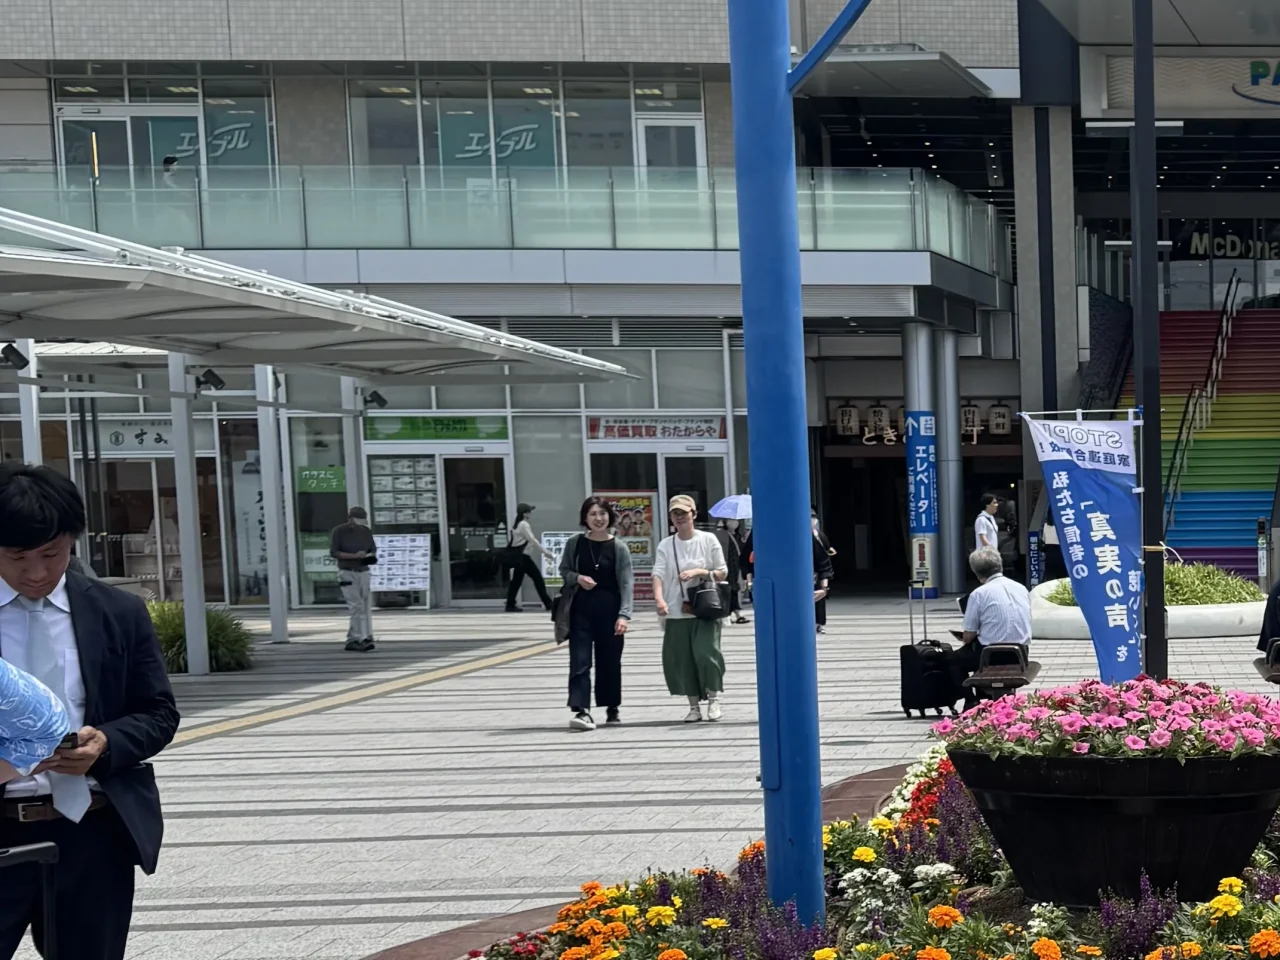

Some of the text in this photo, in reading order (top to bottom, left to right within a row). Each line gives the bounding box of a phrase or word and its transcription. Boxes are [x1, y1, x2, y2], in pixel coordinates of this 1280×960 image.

[915, 445, 928, 527] エレベーター
